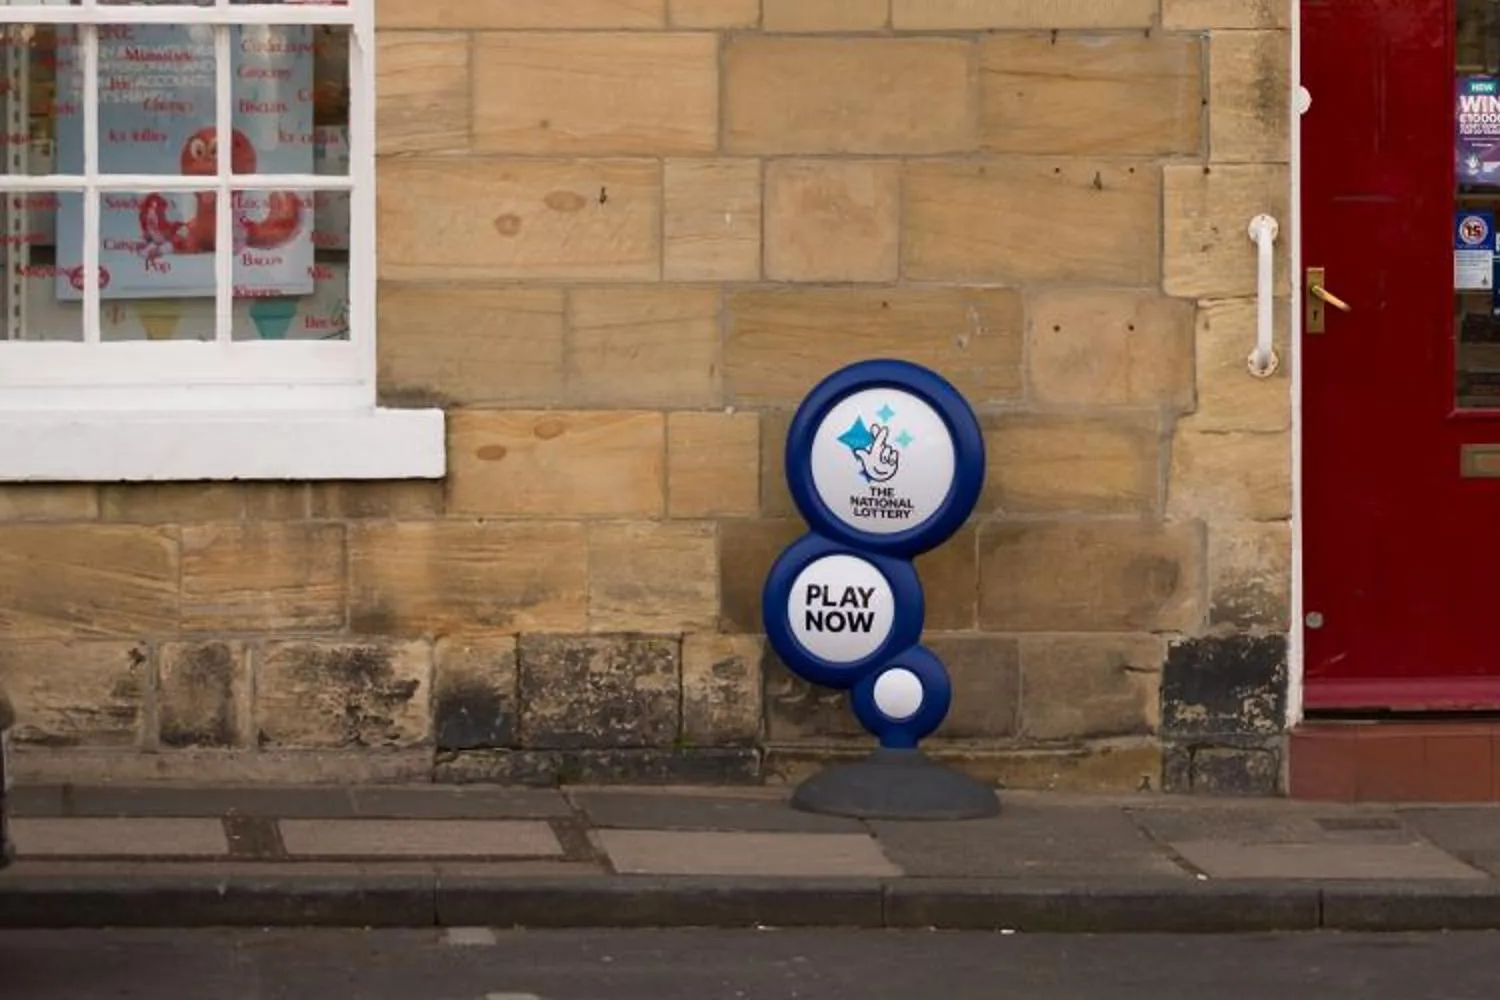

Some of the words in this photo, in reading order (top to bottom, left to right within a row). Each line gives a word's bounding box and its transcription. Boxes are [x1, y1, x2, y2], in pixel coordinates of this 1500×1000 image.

[870, 487, 895, 498] THE
[849, 496, 914, 510] NATIONAL
[853, 507, 912, 520] LOTTERY
[805, 583, 876, 609] PLAY
[804, 610, 876, 634] NOW
